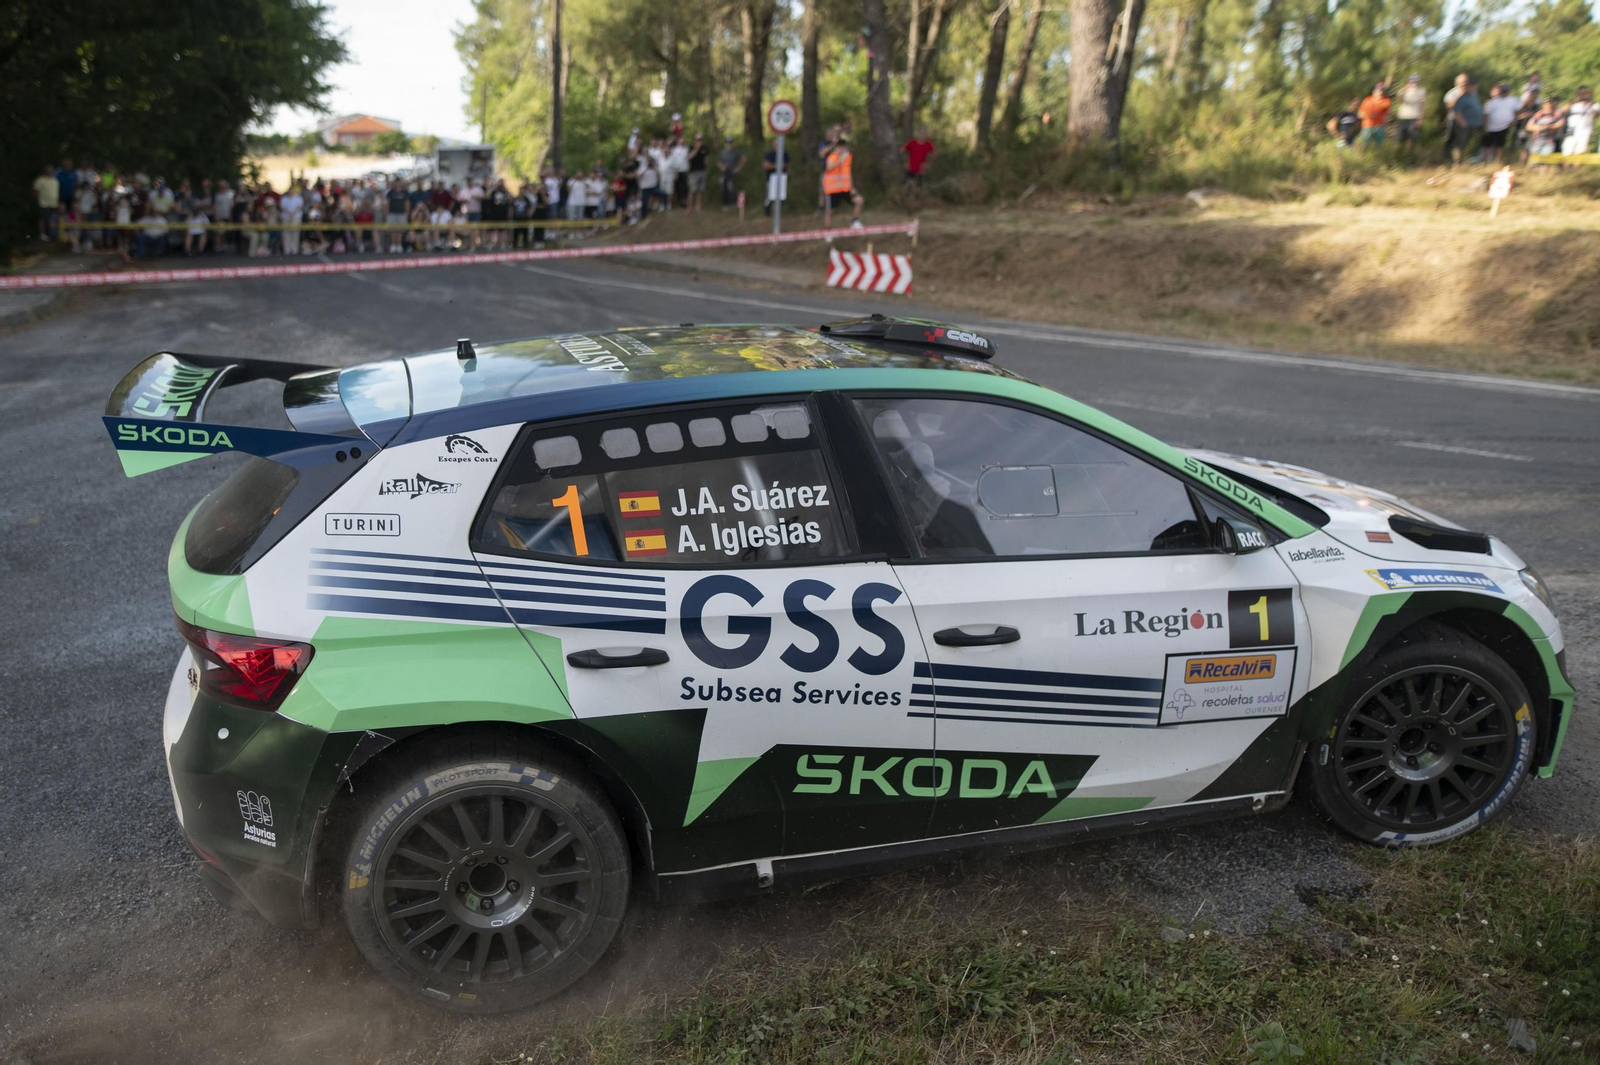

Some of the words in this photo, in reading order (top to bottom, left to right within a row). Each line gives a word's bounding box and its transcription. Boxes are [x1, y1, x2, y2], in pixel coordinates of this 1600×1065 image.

[438, 456, 472, 464] Escapes
[380, 476, 462, 497] Rallycar
[671, 486, 725, 516] J.A.
[731, 481, 830, 511] Suárez
[332, 518, 394, 531] TURINI
[552, 485, 589, 556] 1
[678, 524, 706, 553] A.
[711, 518, 822, 556] Iglesias
[1237, 531, 1266, 548] RACC
[1410, 574, 1495, 587] MICHELIN
[680, 574, 906, 676] GSS
[1073, 612, 1117, 637] La
[1122, 607, 1224, 638] Región
[1249, 595, 1270, 641] 1
[1202, 660, 1259, 678] Recalvi
[680, 676, 782, 702] Subsea
[792, 681, 902, 706] Services
[1201, 694, 1254, 708] recoletas
[1257, 691, 1287, 704] salud
[1204, 685, 1245, 694] HOSPITAL
[1244, 705, 1283, 714] OURENSE
[434, 772, 462, 789] PILOT
[464, 768, 500, 778] SPORT
[1484, 736, 1531, 818] MICHELIN
[244, 821, 276, 841] Asturias
[359, 786, 423, 860] MICHELIN
